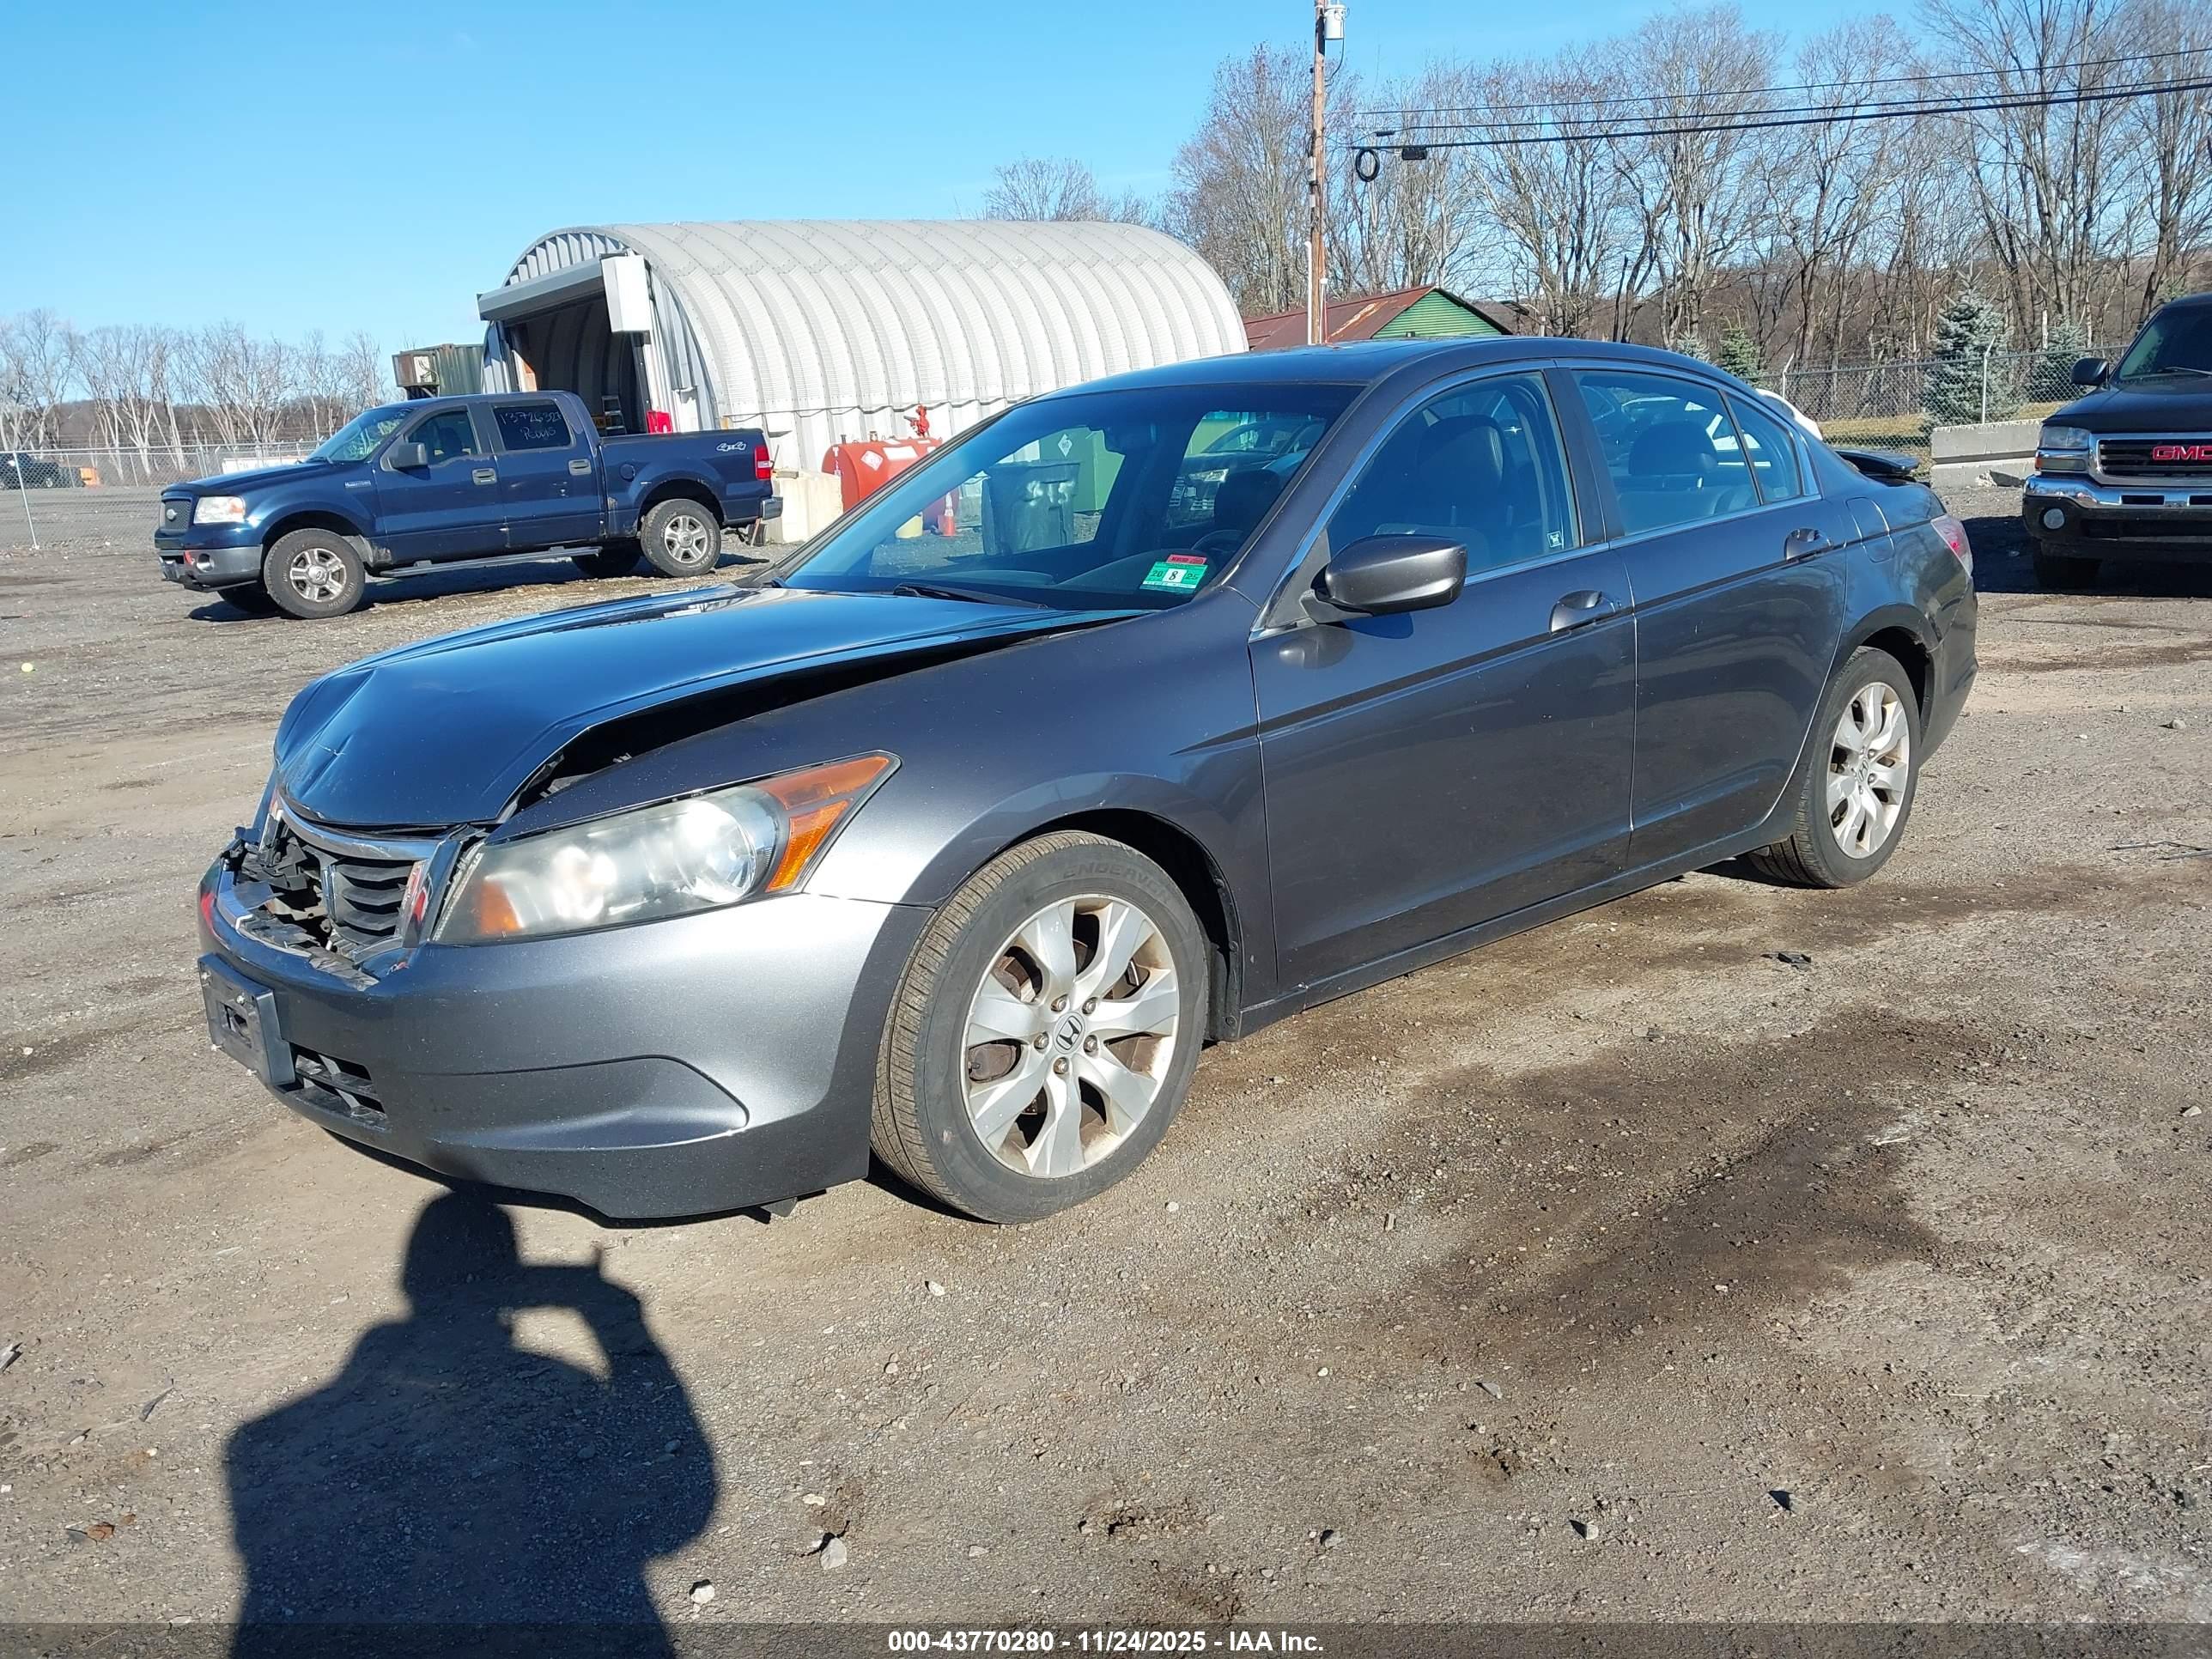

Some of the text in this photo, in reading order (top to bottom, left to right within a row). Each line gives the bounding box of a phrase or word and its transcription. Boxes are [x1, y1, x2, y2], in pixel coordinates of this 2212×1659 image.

[2152, 445, 2212, 460] GMC
[1152, 569, 1164, 578] 20
[1169, 570, 1179, 580] 8
